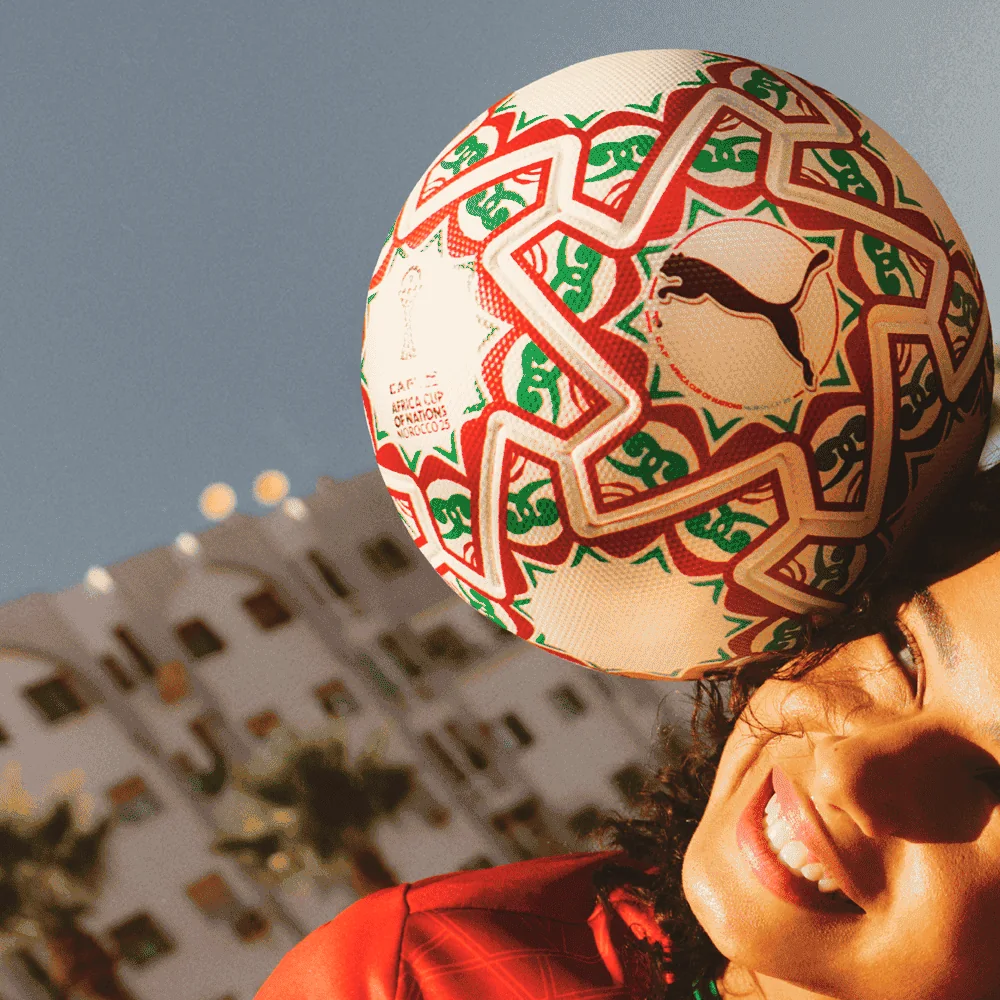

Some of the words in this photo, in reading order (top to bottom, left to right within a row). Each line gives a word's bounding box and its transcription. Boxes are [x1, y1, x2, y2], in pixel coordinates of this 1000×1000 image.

[670, 363, 690, 386] AFRICA
[389, 378, 414, 395] CAF
[392, 395, 422, 414] AFRICA
[423, 391, 444, 406] CUP
[394, 414, 405, 428] OF
[406, 405, 447, 424] NATIONS
[397, 421, 438, 439] MOROCCO
[438, 418, 450, 431] 25
